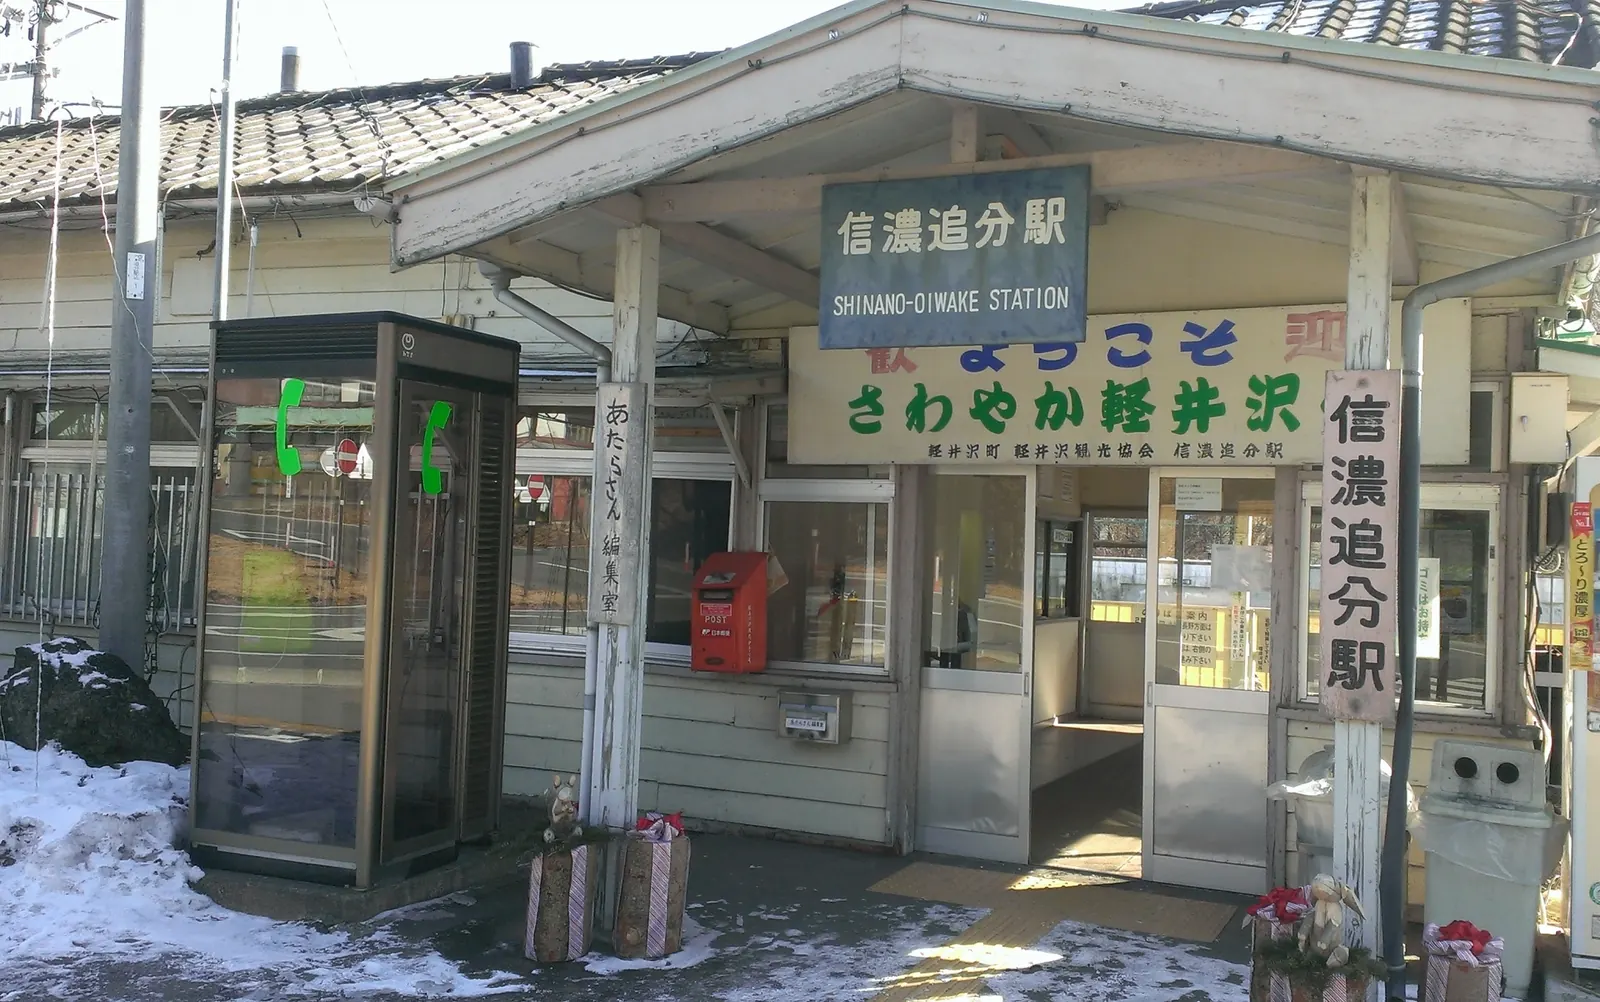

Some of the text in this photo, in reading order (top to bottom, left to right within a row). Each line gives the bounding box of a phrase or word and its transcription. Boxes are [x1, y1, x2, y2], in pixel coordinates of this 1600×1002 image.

[837, 196, 1066, 255] 信濃追分駅
[833, 286, 1070, 316] SHINANO-OIWAKE STATION
[848, 372, 1325, 435] さわやか軽井沢
[928, 440, 1285, 461] 軽井沢町 軽井沢観光協会 信濃追分駅
[1327, 394, 1391, 692] 信濃追分駅
[704, 615, 727, 624] POST
